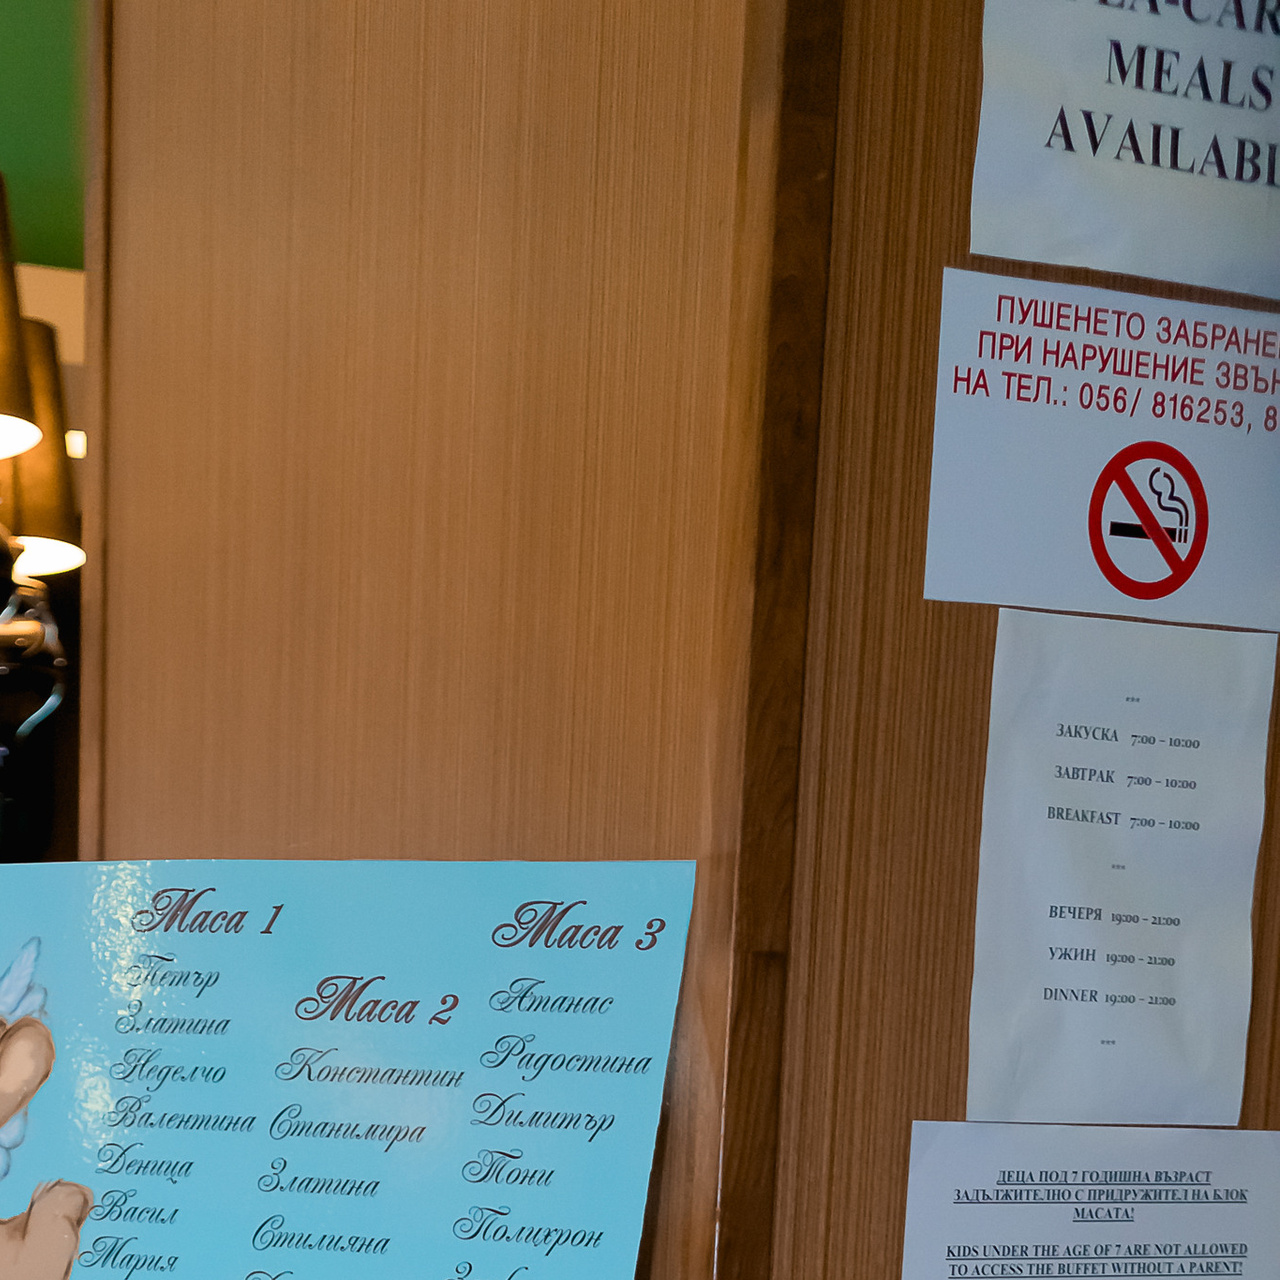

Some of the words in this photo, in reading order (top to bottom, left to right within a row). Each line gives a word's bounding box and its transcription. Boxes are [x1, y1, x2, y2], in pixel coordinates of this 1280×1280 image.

[1105, 39, 1274, 112] MEALS
[996, 294, 1146, 340] ПУШЕНЕТО
[1156, 316, 1280, 358] ЗАБРАНЕ
[978, 330, 1032, 364] ПРИ
[1042, 339, 1205, 385] НАРУШЕНИЕ
[953, 365, 989, 397] НА
[1079, 382, 1142, 417] 056/
[1152, 391, 1252, 435] 816253,
[1056, 723, 1119, 742] ЗАКУСКА
[1054, 765, 1115, 783] ЗАВТРАК
[1047, 806, 1121, 825] BREAKFAST
[132, 887, 249, 935] Маса
[261, 904, 285, 935] 1
[1049, 905, 1102, 921] ВЕЧЕРЯ
[491, 900, 623, 950] Маса
[635, 919, 666, 950] 3
[1048, 947, 1096, 961] УЖИН
[294, 975, 420, 1024] Маса
[429, 993, 459, 1025] 2
[1043, 987, 1098, 1002] DINNER
[997, 1171, 1035, 1184] ДЕЦА
[1039, 1171, 1068, 1184] ПОД
[1082, 1171, 1151, 1184] ГОДИШНА
[1155, 1171, 1212, 1183] ВЪЗРАСТ
[954, 1189, 1071, 1201] ЗАДЪЛЖИТЕЛНО
[1088, 1189, 1188, 1201] ПРИДРУЖИТЕЛ
[1214, 1189, 1248, 1200] БЛОК
[1073, 1208, 1134, 1219] МАСАТА!
[947, 1246, 979, 1257] KIDS
[983, 1246, 1029, 1257] UNDER
[1033, 1245, 1059, 1256] THE
[1063, 1245, 1090, 1256] AGE
[1124, 1244, 1151, 1255] ARE
[1154, 1244, 1181, 1255] NOT
[1184, 1243, 1247, 1255] ALLOWED
[971, 1264, 1023, 1275] ACCESS
[1027, 1263, 1054, 1275] THE
[1058, 1263, 1108, 1274] BUFFET
[1112, 1263, 1174, 1273] WITHOUT
[1190, 1262, 1243, 1273] PARENT!
